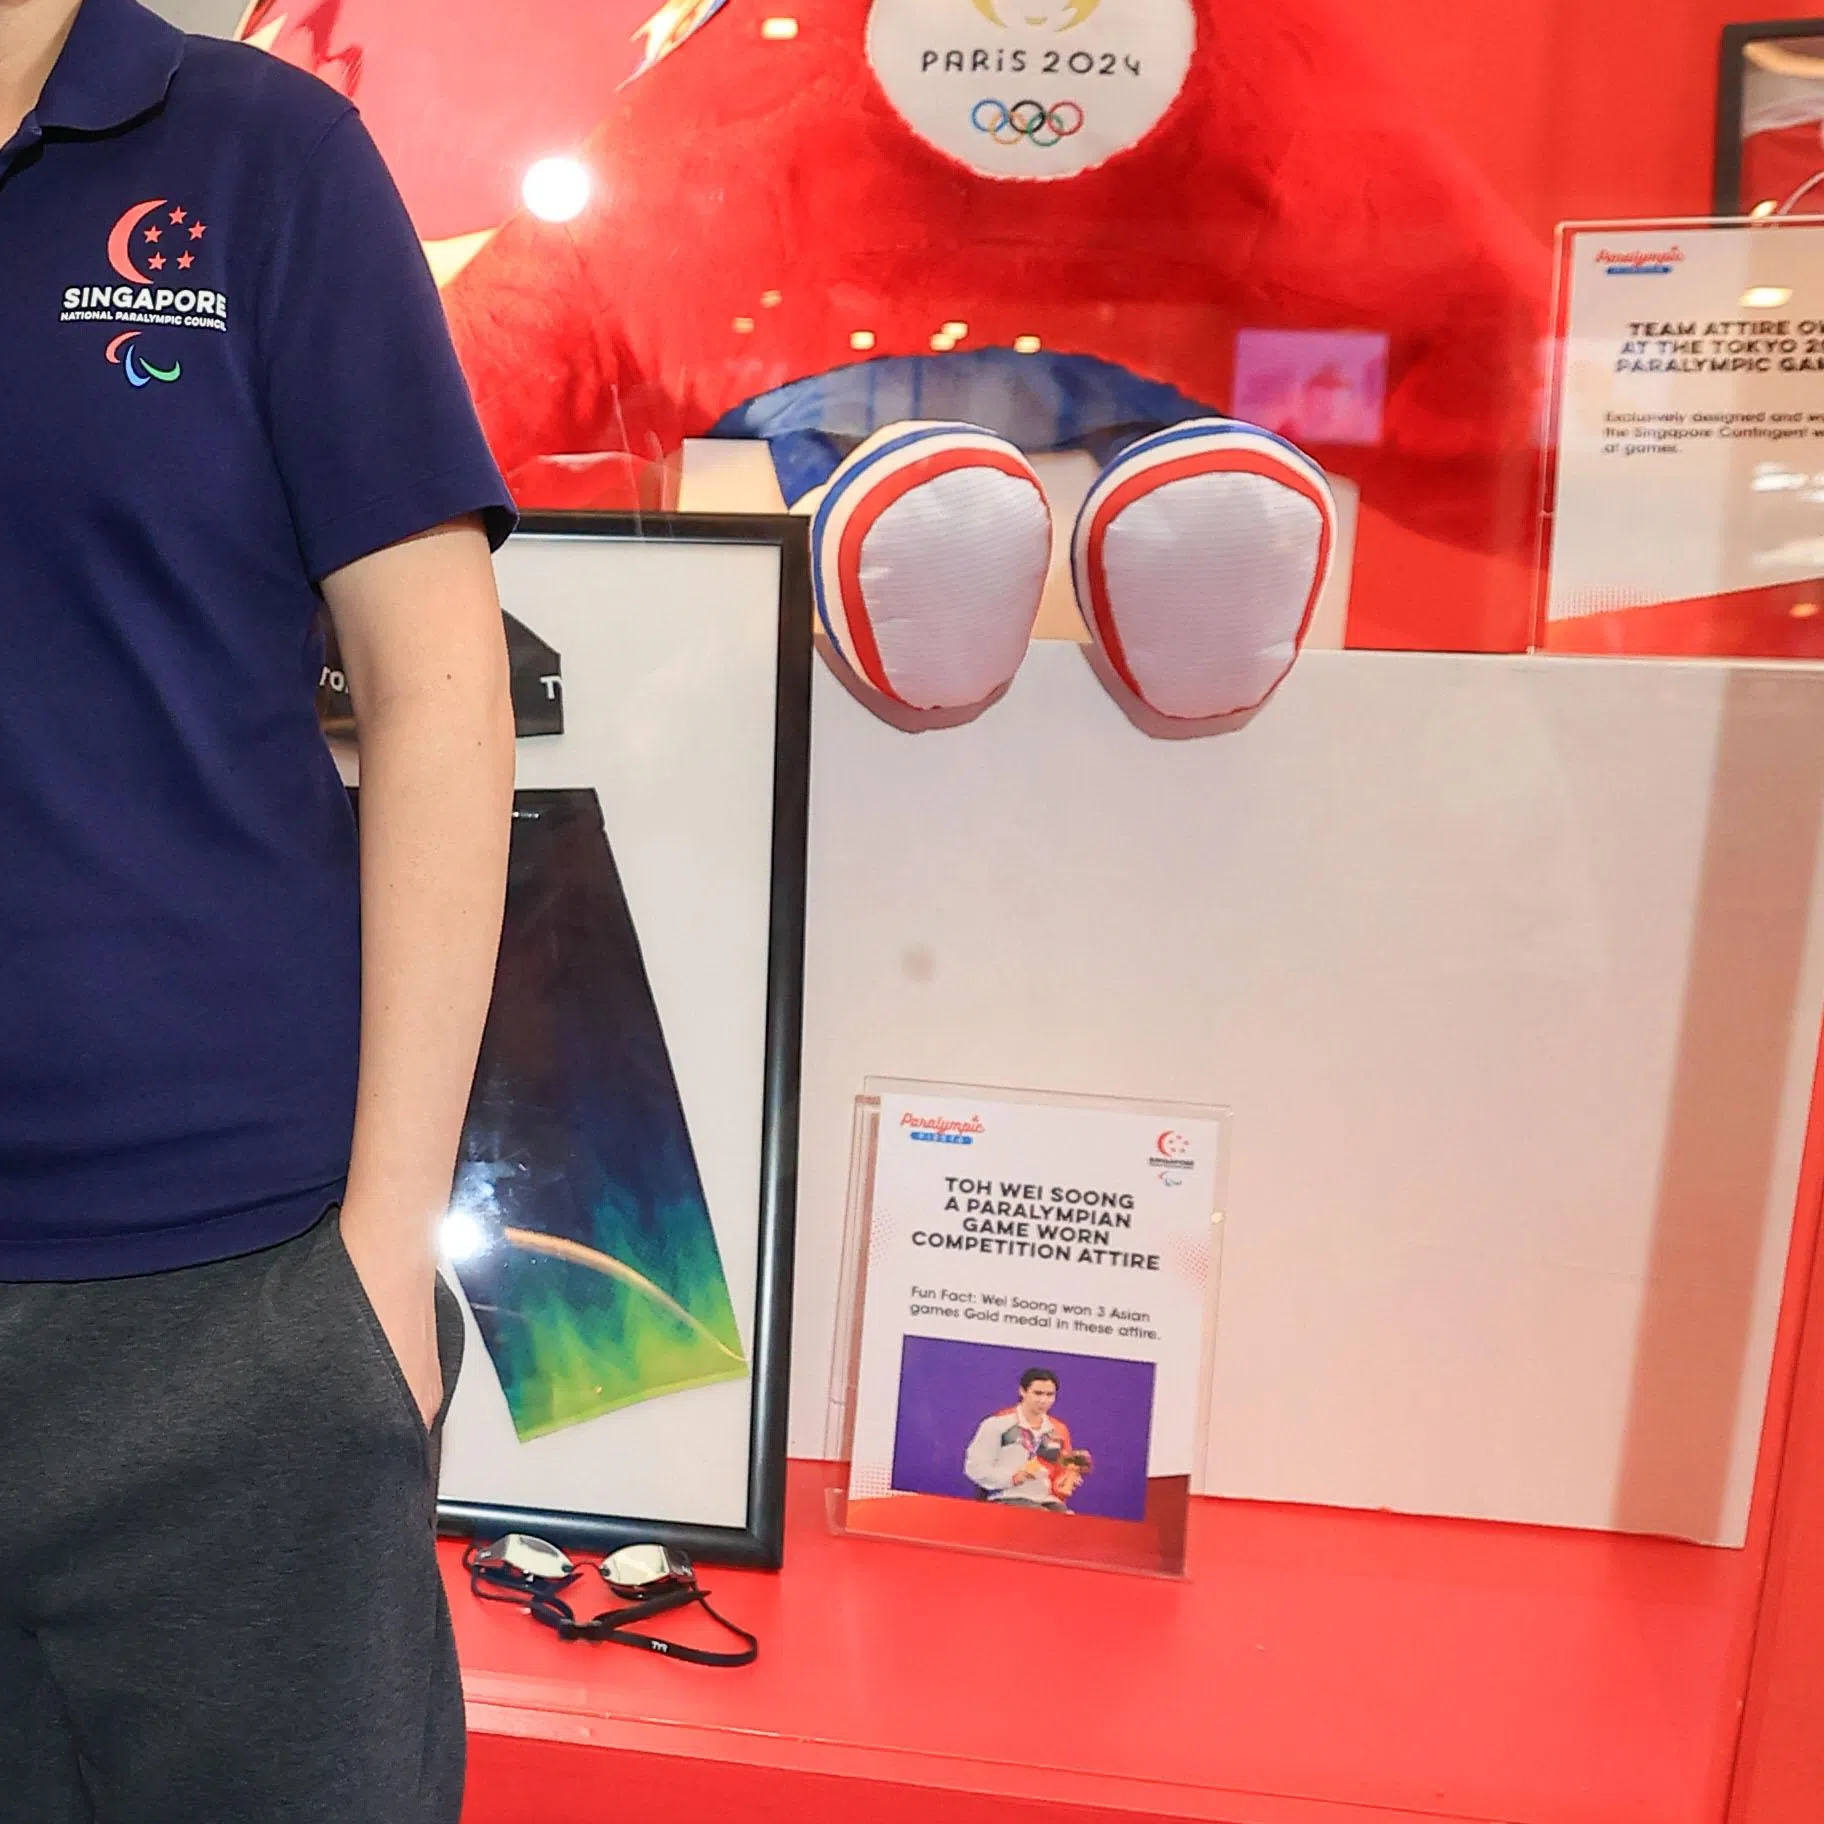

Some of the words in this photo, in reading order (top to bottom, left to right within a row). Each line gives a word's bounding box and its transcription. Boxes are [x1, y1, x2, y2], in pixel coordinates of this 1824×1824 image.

[1041, 50, 1142, 76] 2024
[62, 286, 227, 318] SINGAPORE
[60, 311, 114, 323] NATIONAL
[115, 311, 182, 326] PARALYMPIC
[183, 316, 227, 332] COUNCIL
[1629, 321, 1696, 337] TEAM
[1703, 320, 1790, 337] ATTIRE
[1621, 340, 1649, 354] AT
[1658, 339, 1704, 354] THE
[1712, 338, 1798, 354] TOKYO
[1615, 357, 1772, 373] PARALYMPIC
[1605, 411, 1687, 425] Exclusively
[1692, 411, 1766, 425] designed
[1770, 412, 1803, 423] and
[1604, 427, 1627, 438] the
[1634, 427, 1713, 441] Singapore
[1719, 427, 1808, 441] Contingent
[900, 1112, 985, 1135] Paralympic
[945, 1176, 992, 1196] TOH
[1000, 1182, 1043, 1201] WEI
[1051, 1187, 1135, 1210] SOONG
[944, 1196, 960, 1212] A
[967, 1198, 1132, 1229] PARALYMPIAN
[963, 1217, 1029, 1238] GAME
[1037, 1223, 1110, 1246] WORN
[911, 1231, 1072, 1262] COMPETITION
[1077, 1248, 1161, 1271] ATTIRE
[911, 1286, 936, 1299] Fun
[941, 1289, 977, 1304] Fact:
[981, 1293, 1008, 1307] Wei
[1012, 1296, 1057, 1315] Soong
[1062, 1305, 1092, 1317] won
[1097, 1305, 1106, 1318] 3
[1110, 1307, 1150, 1323] Asian
[910, 1303, 959, 1318] games
[964, 1307, 999, 1323] Gold
[1004, 1312, 1052, 1328] medal
[1056, 1317, 1069, 1330] in
[1074, 1319, 1113, 1336] these
[1118, 1325, 1162, 1341] attire.
